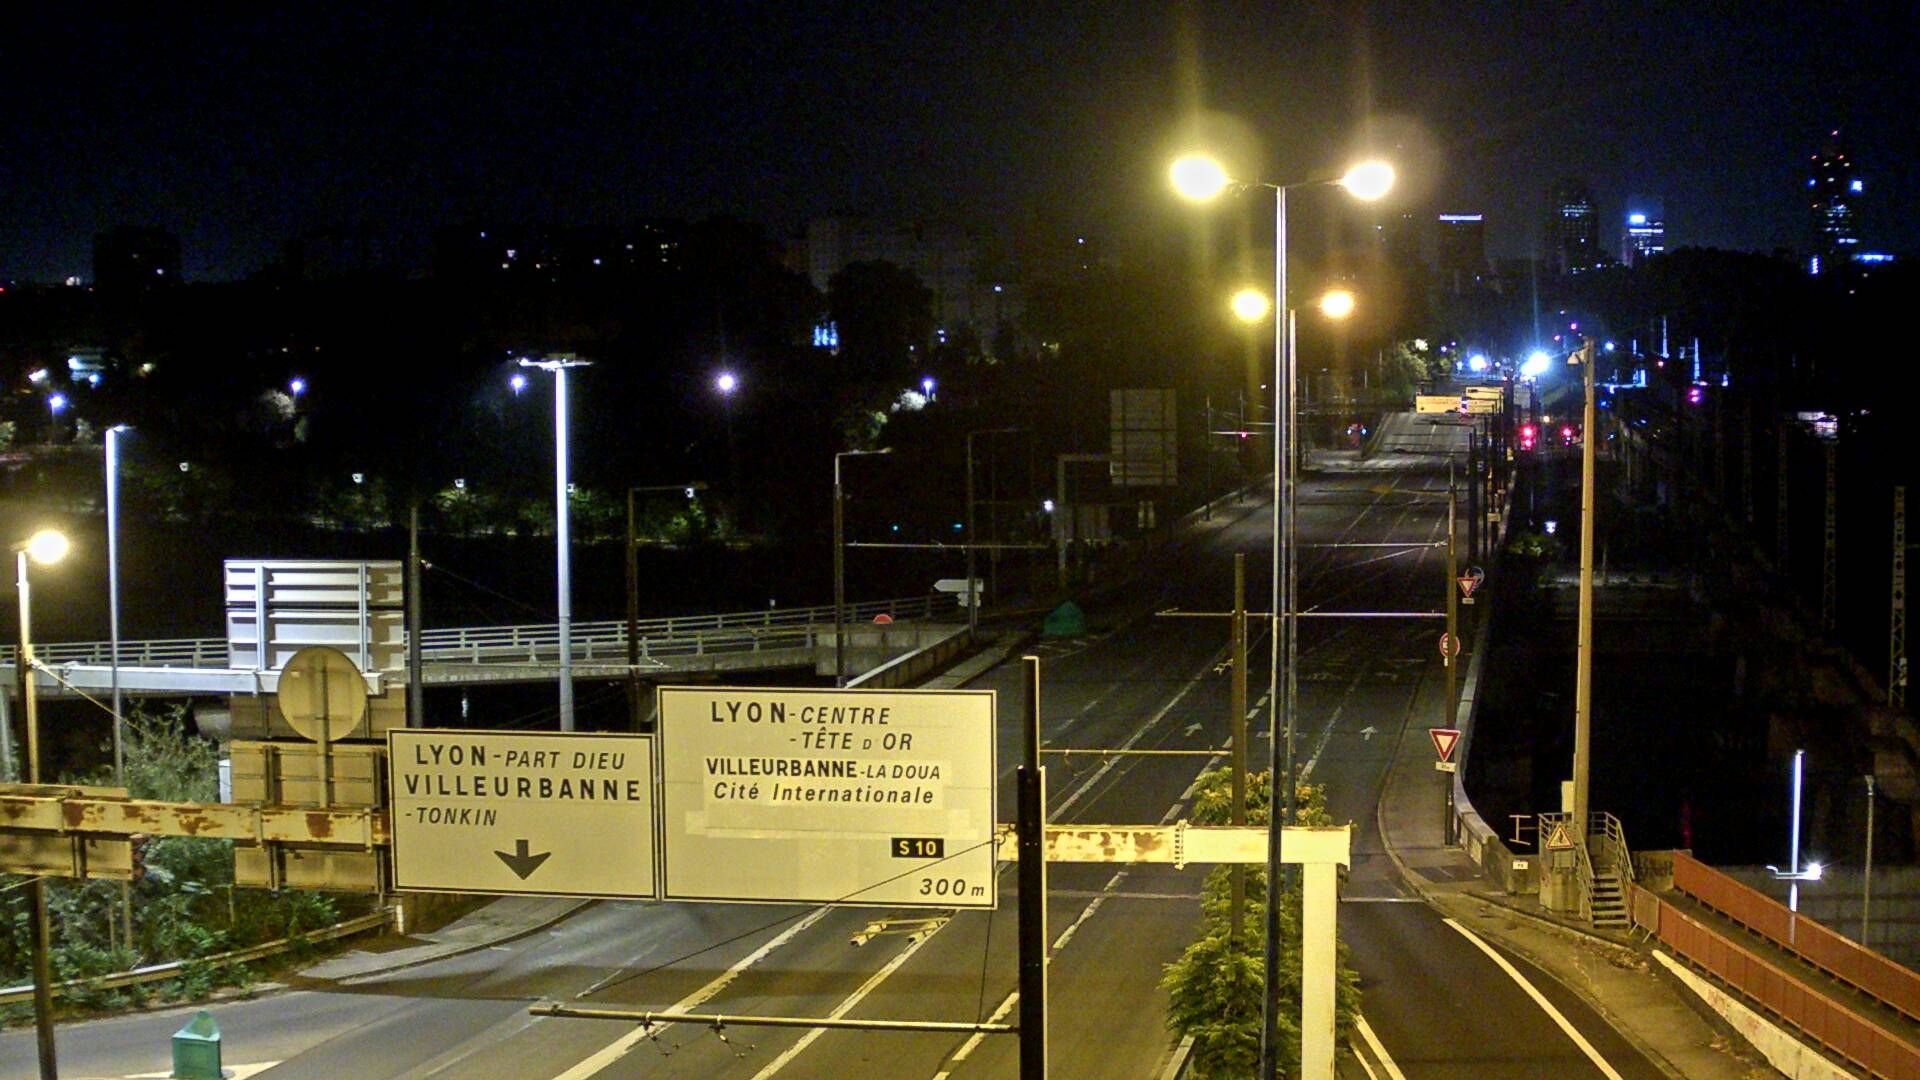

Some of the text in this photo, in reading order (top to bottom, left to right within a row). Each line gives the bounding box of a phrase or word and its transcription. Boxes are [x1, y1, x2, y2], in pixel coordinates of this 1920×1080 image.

[882, 732, 913, 751] OR
[572, 752, 626, 770] DIEU
[891, 764, 941, 780] DOUA
[404, 773, 641, 802] VILLEURBANNE
[713, 781, 934, 805] Cité Internationale
[899, 839, 937, 856] S 10
[919, 877, 985, 897] 300 m
